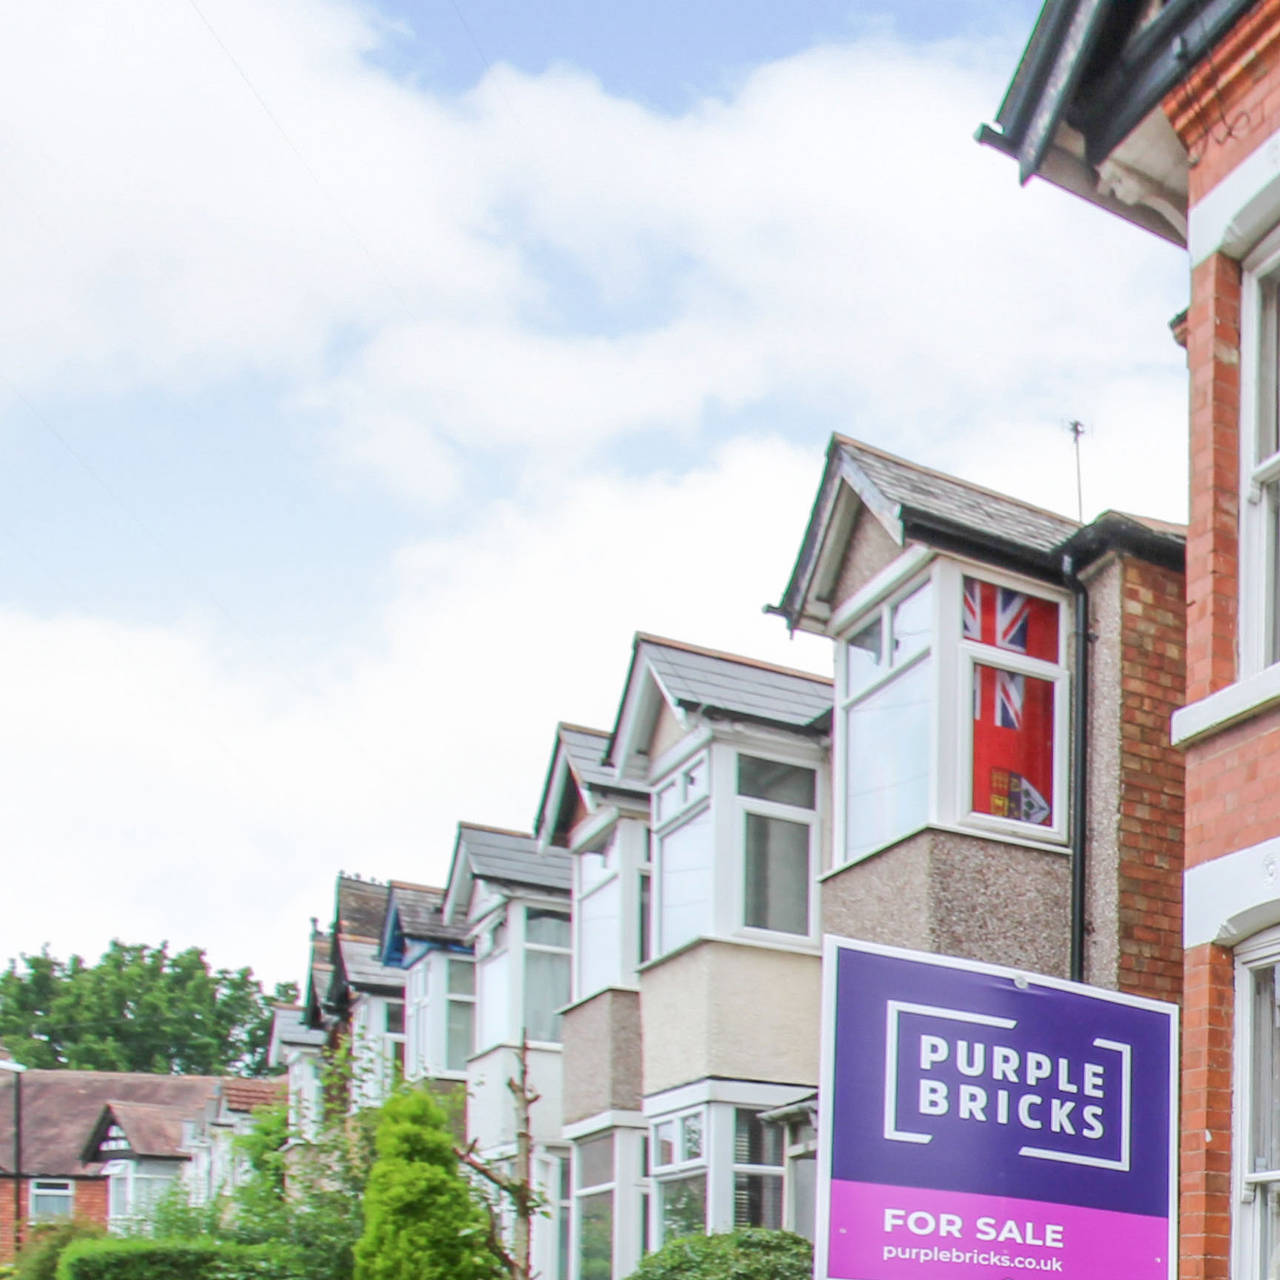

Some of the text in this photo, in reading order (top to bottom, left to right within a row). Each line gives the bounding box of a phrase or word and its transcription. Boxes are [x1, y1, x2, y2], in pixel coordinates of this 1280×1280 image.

[920, 1034, 1105, 1099] PURPLE
[918, 1079, 1105, 1139] BRICKS
[883, 1208, 1064, 1248] FOR SALE
[882, 1244, 1063, 1272] purplebricks.co.uk
